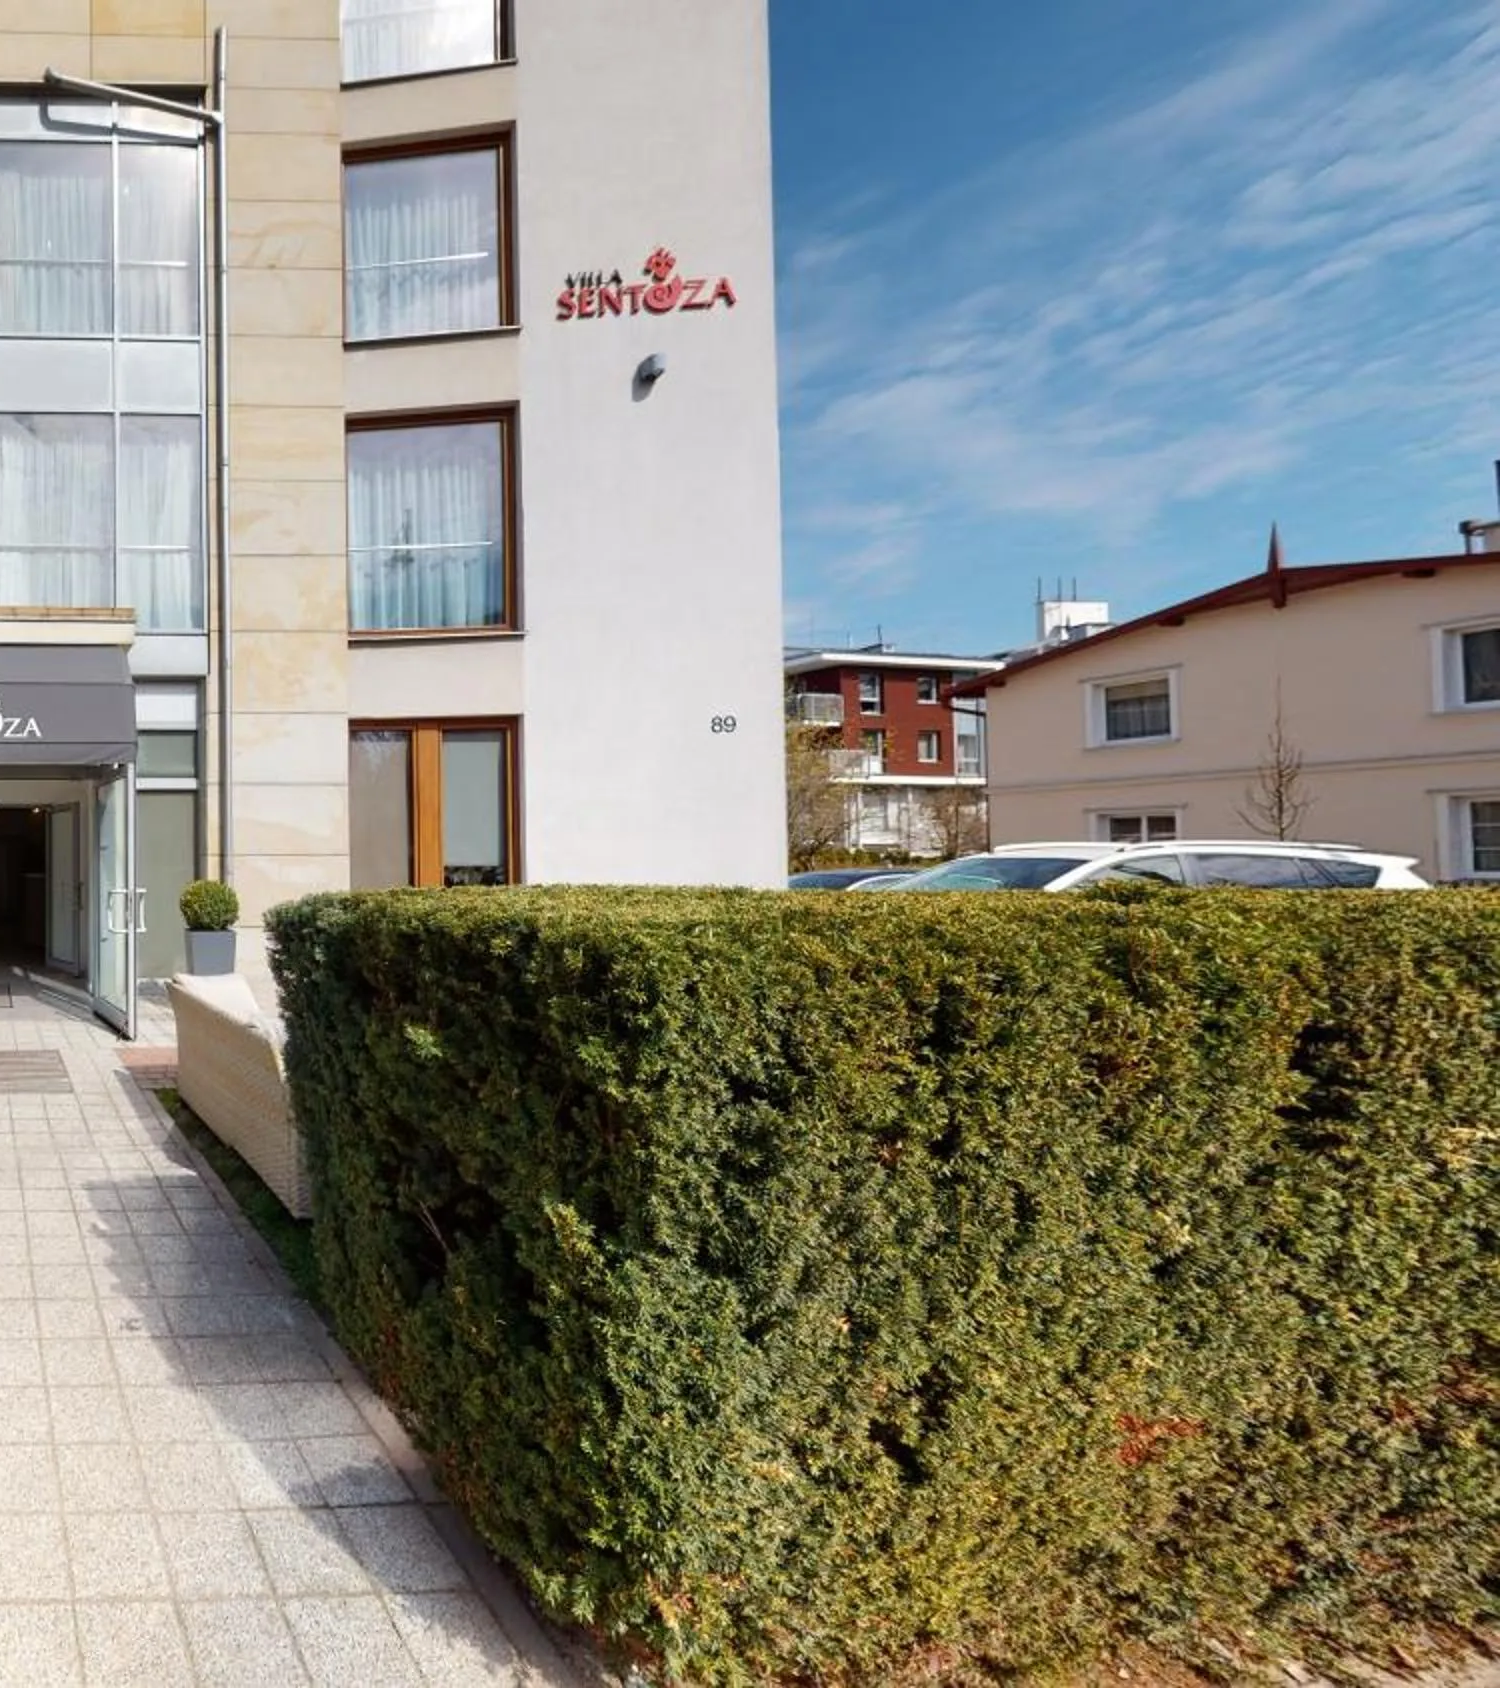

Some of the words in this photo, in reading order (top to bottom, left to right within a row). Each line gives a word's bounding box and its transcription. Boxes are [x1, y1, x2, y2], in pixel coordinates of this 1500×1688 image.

[565, 268, 623, 289] VILLA
[556, 275, 736, 322] SENTOZA
[711, 715, 736, 733] 89
